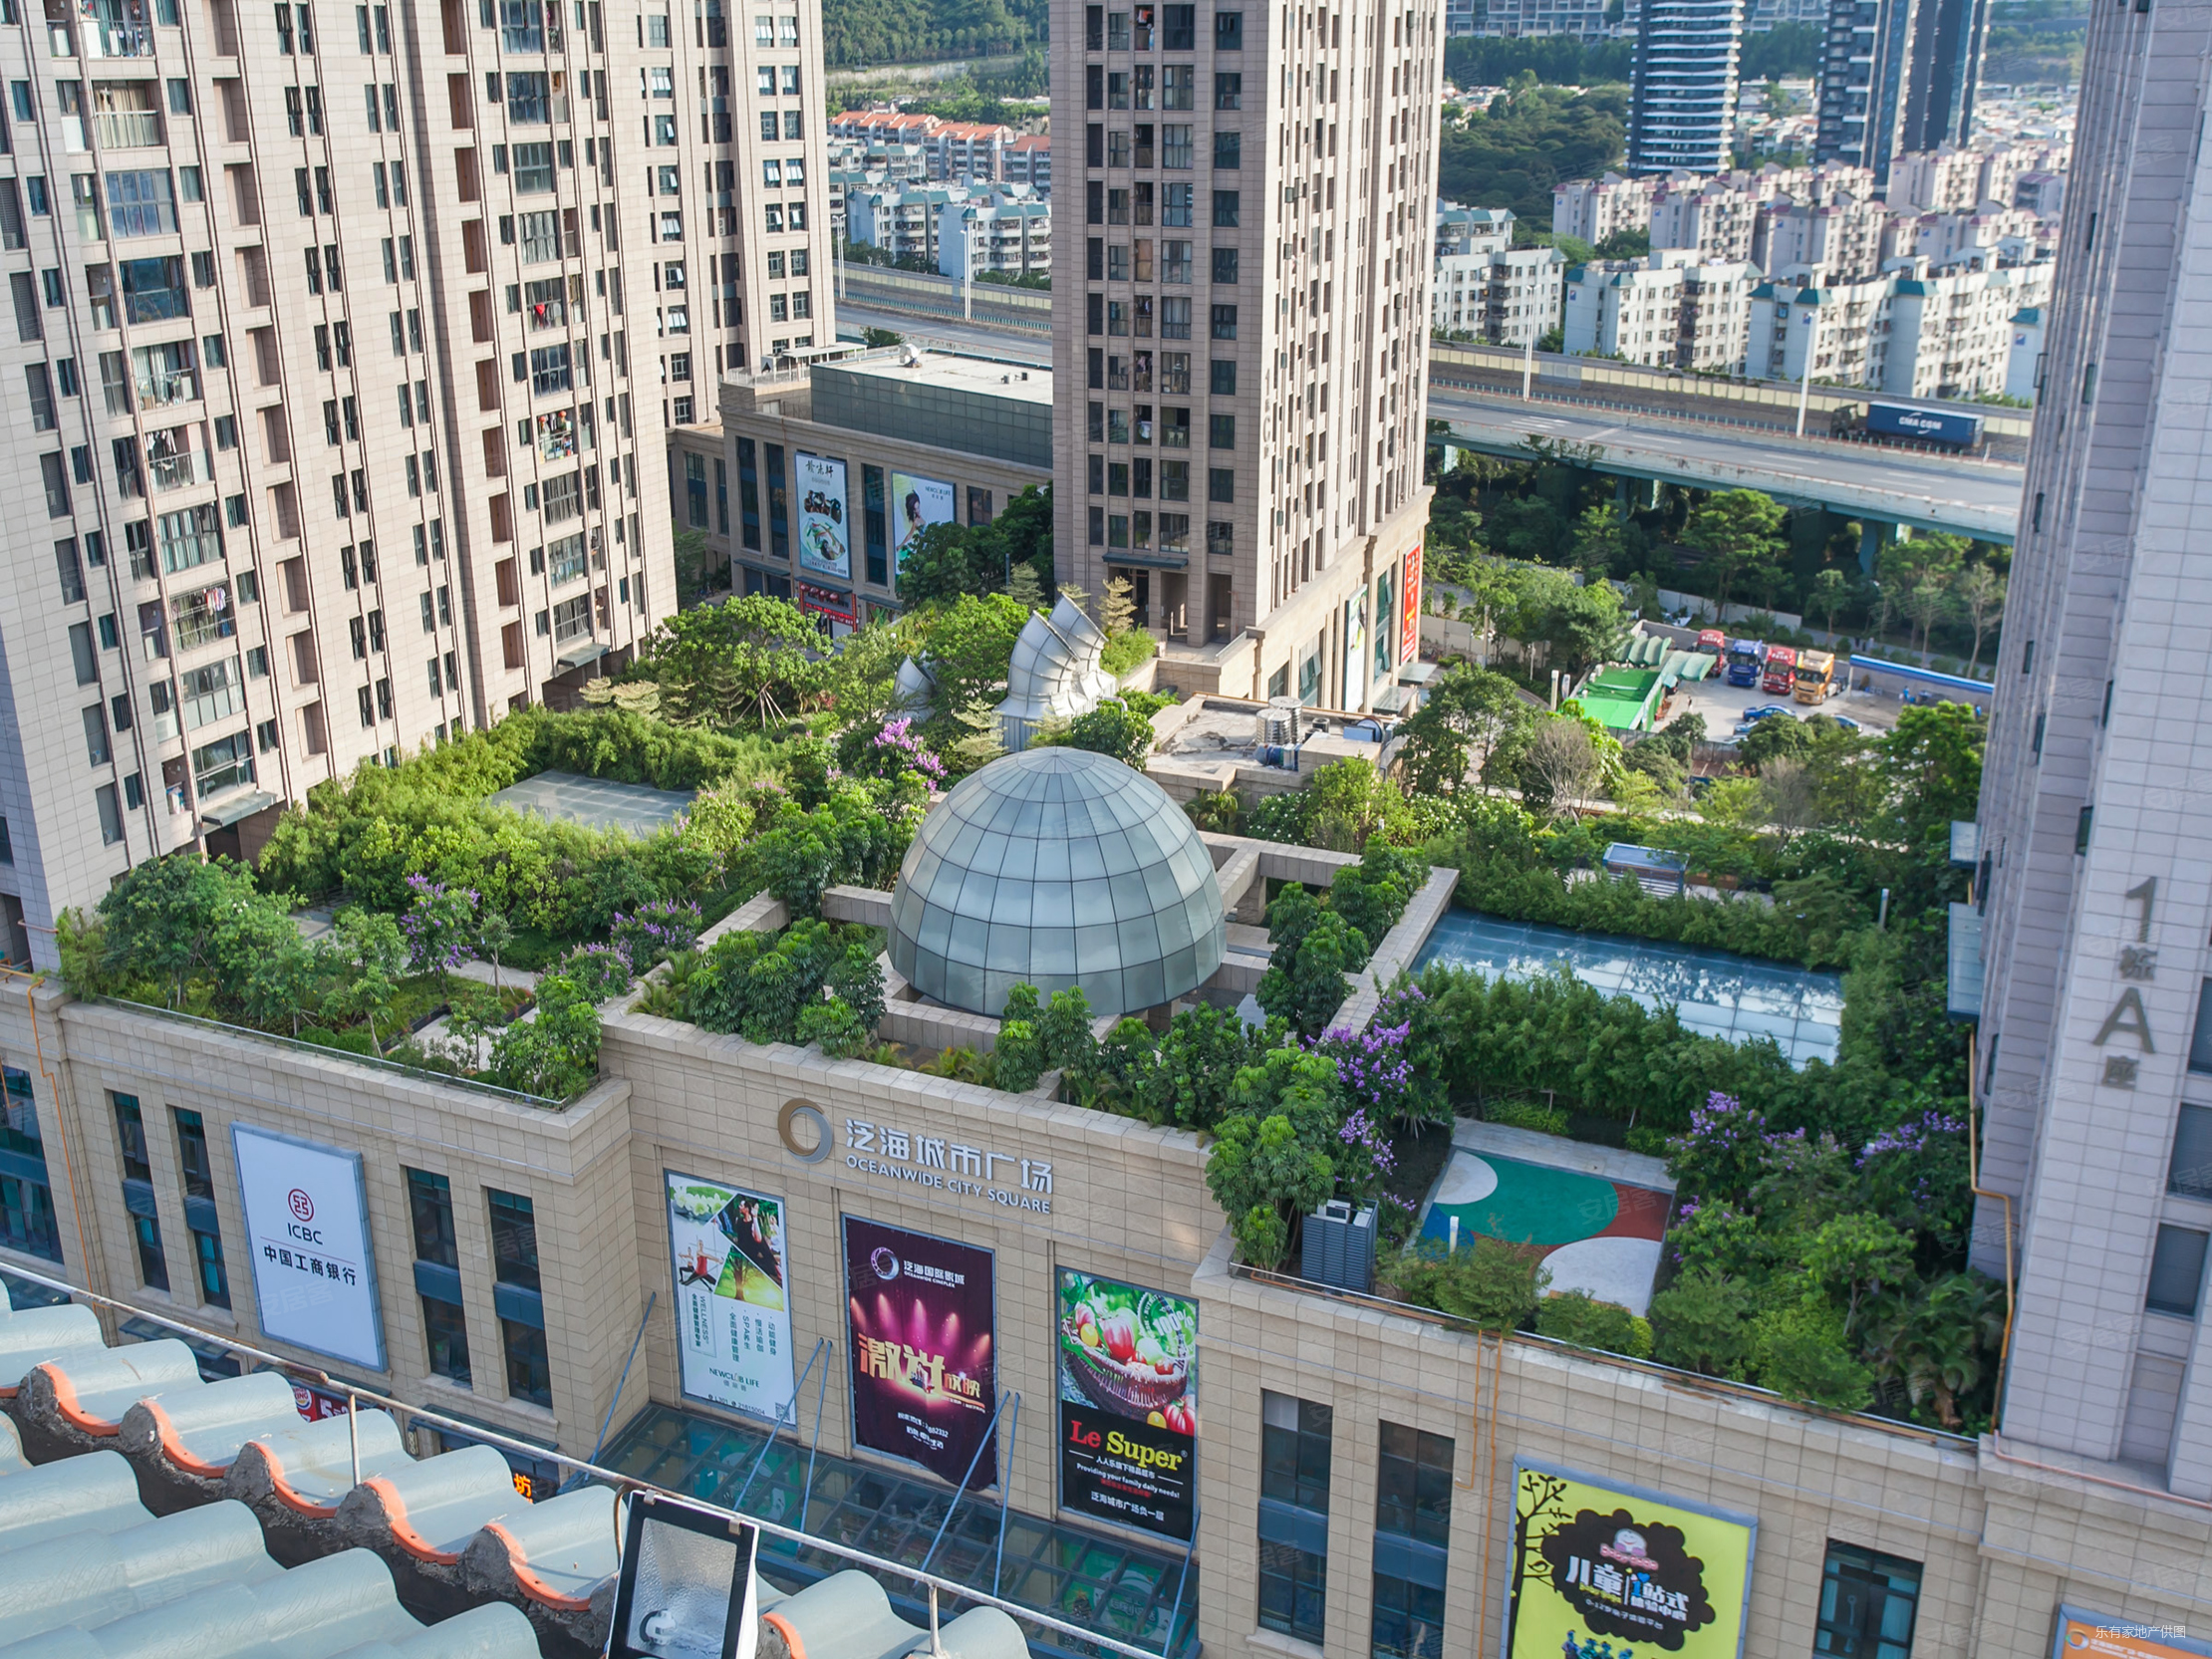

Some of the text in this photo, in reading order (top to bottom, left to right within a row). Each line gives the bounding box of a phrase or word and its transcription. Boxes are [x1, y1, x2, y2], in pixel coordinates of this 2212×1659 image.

[1898, 415, 1942, 430] CMA CGM
[845, 1117, 1053, 1195] 泛海城市广场
[845, 1154, 1051, 1215] OCEANWIDE CITY SQUARE
[287, 1222, 324, 1245] ICBC
[263, 1244, 358, 1286] 中国工商银行
[903, 1259, 966, 1285] 泛海国际影城
[1152, 1308, 1195, 1337] 100%
[745, 1378, 760, 1388] LIFE
[1069, 1420, 1183, 1472] Le Super
[1076, 1462, 1106, 1479] Providing
[1107, 1470, 1122, 1482] your
[1122, 1476, 1141, 1490] family
[1142, 1482, 1158, 1495] daily
[1090, 1491, 1165, 1521] 泛海城市广场负一层
[1565, 1555, 1624, 1596] 儿童
